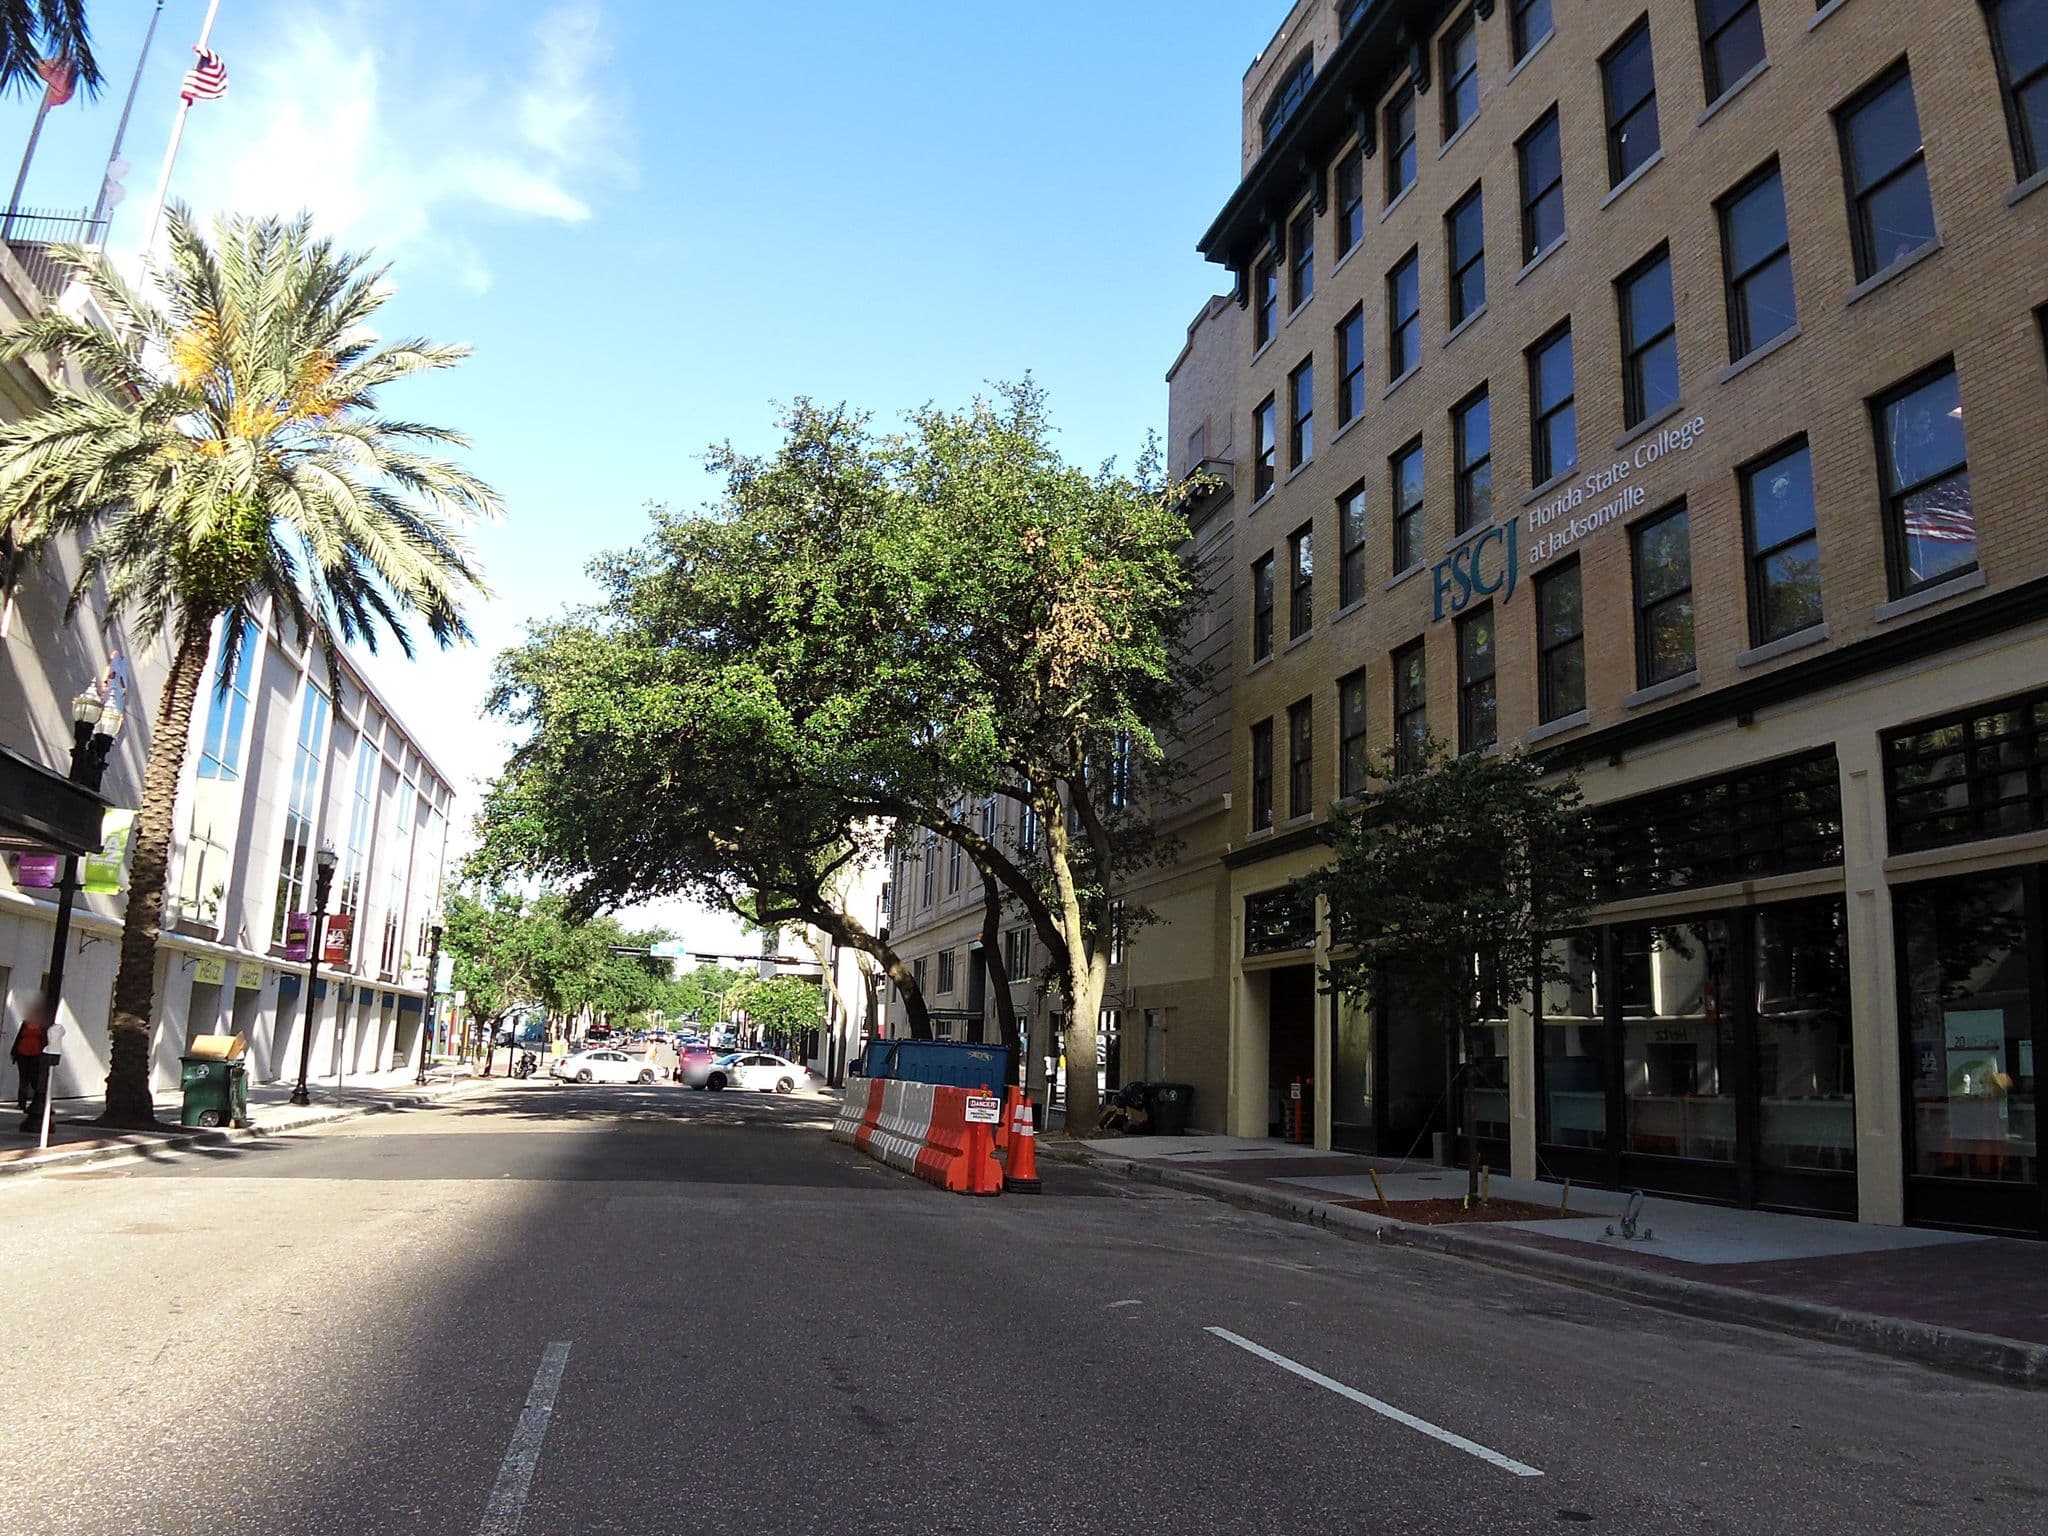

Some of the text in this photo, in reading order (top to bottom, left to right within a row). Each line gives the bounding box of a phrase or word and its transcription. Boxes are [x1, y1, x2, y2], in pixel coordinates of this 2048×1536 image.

[1528, 416, 1705, 532] Florida State College
[1430, 515, 1519, 622] FSCJ
[1529, 486, 1645, 564] at Jacksonville
[970, 1100, 997, 1108] DANGER
